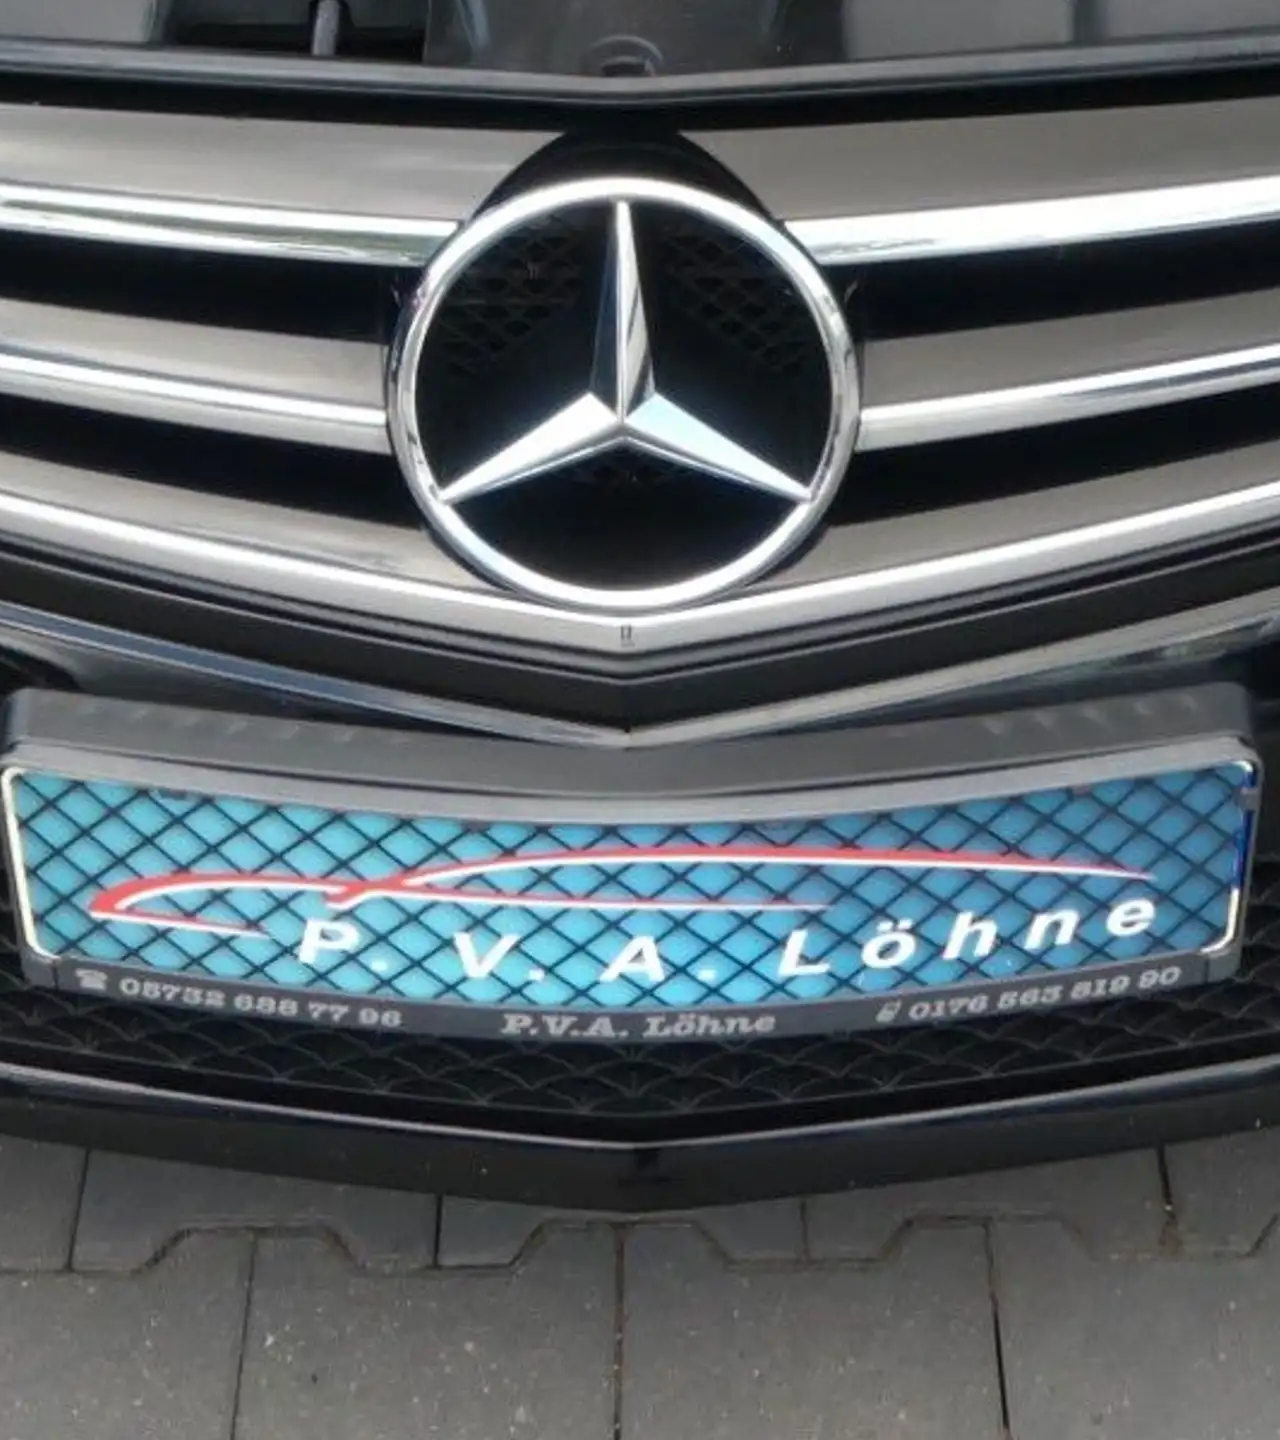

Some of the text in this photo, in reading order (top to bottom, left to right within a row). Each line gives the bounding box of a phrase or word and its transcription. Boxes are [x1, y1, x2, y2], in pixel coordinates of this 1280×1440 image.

[776, 897, 1157, 978] Löhne
[308, 999, 350, 1023] 77
[907, 992, 990, 1021] 0176
[500, 1013, 777, 1038] P.V.A. Löhne
